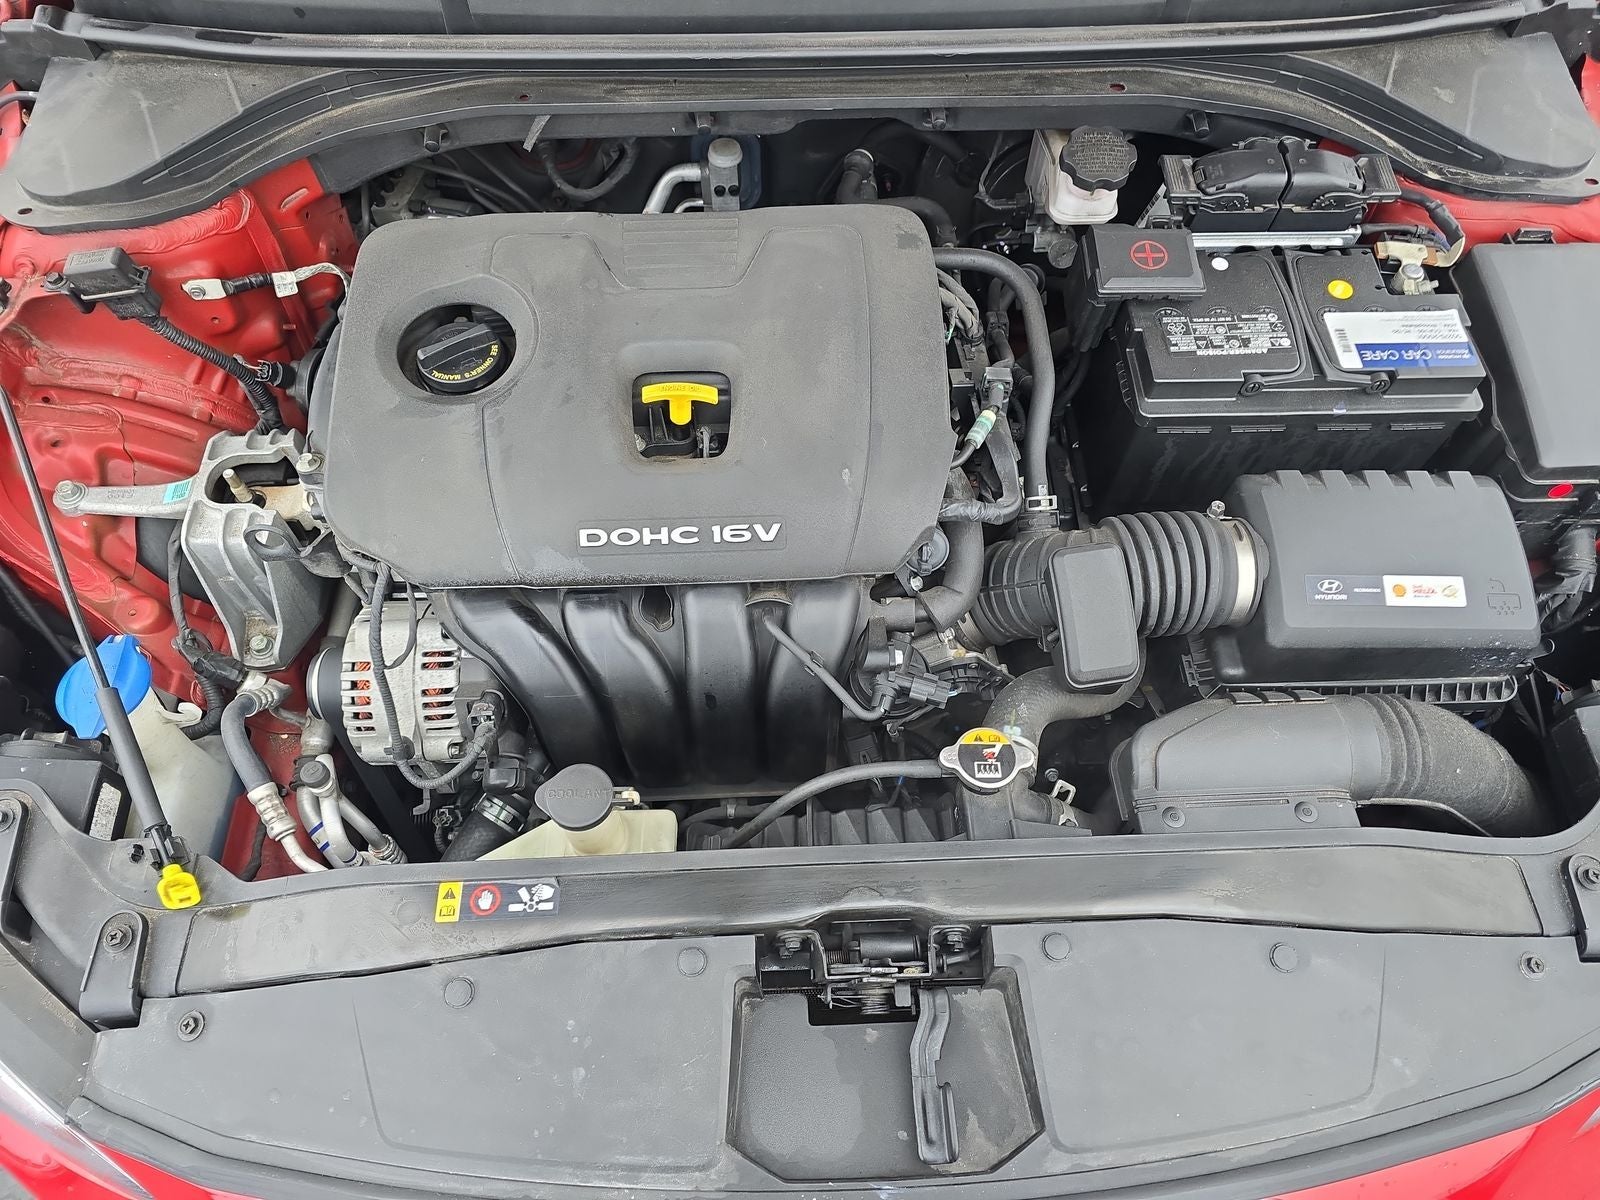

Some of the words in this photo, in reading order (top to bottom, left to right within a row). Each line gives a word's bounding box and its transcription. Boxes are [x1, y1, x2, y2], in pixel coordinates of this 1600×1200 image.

[489, 344, 498, 356] SEE
[1360, 349, 1399, 360] CARE
[1401, 349, 1432, 360] CAR
[464, 357, 494, 378] OWNER'S
[431, 370, 461, 380] MANUAL
[579, 526, 700, 547] DOHC
[712, 523, 782, 544] 16V
[548, 788, 611, 798] COOLANT
